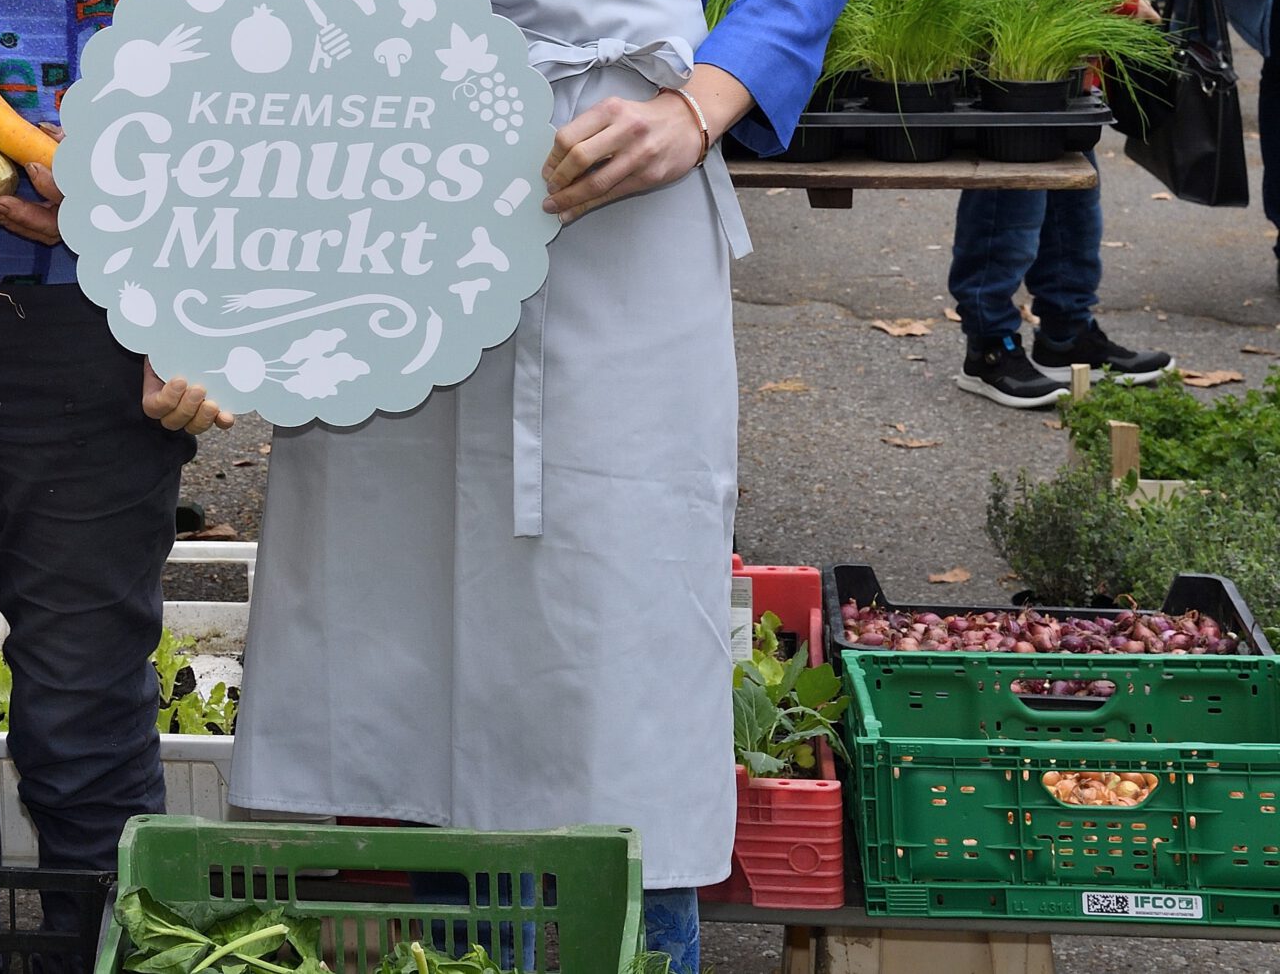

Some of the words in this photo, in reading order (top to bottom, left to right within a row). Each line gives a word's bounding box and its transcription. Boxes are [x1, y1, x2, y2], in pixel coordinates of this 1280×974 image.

[187, 91, 436, 129] KREMSER
[90, 111, 490, 232] Genuss
[153, 206, 438, 276] Markt
[1134, 895, 1177, 909] IFCO
